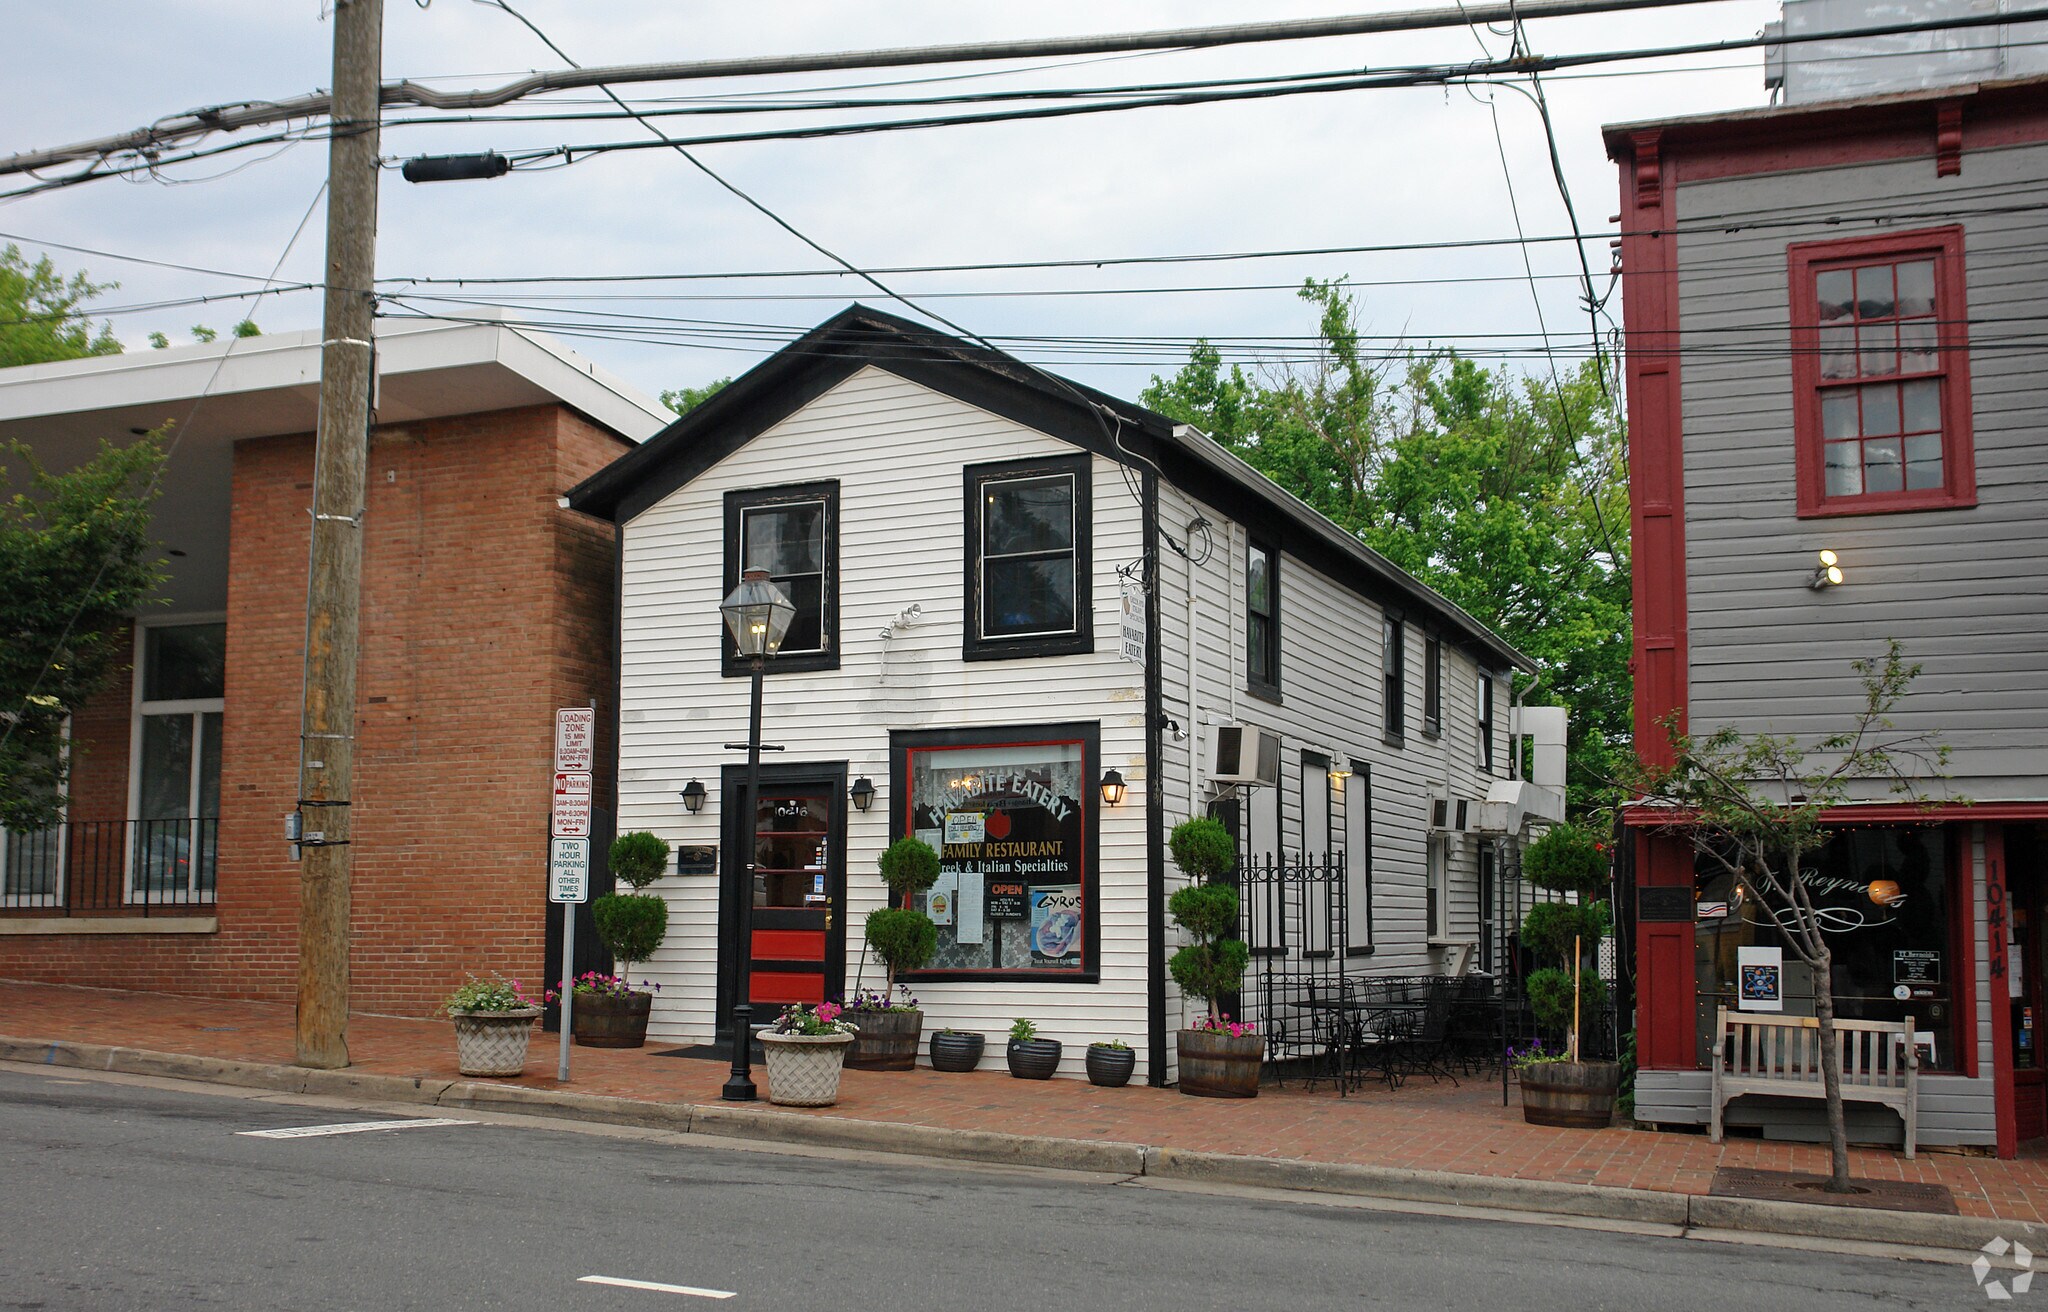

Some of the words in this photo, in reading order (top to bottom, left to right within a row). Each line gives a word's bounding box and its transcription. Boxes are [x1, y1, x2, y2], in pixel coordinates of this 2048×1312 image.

[1123, 625, 1144, 644] HAVABITE
[1125, 642, 1142, 659] EATERY
[559, 714, 591, 723] LOADING
[565, 723, 585, 732] ZONE
[556, 778, 566, 791] NO
[566, 780, 589, 789] PARKING
[1011, 771, 1072, 822] EATERY
[556, 818, 586, 826] MON-FRI
[561, 842, 580, 850] TWO
[941, 843, 981, 859] FAMILY
[985, 840, 1063, 859] RESTAURANT
[558, 851, 581, 859] HOUR
[554, 860, 586, 868] PARKING
[941, 861, 962, 873] reek
[965, 860, 974, 873] &
[977, 861, 1011, 873] Italian
[1013, 859, 1069, 875] Specialties
[991, 884, 1023, 895] OPEN
[1036, 895, 1081, 909] GYROS
[1987, 860, 2005, 978] 10414
